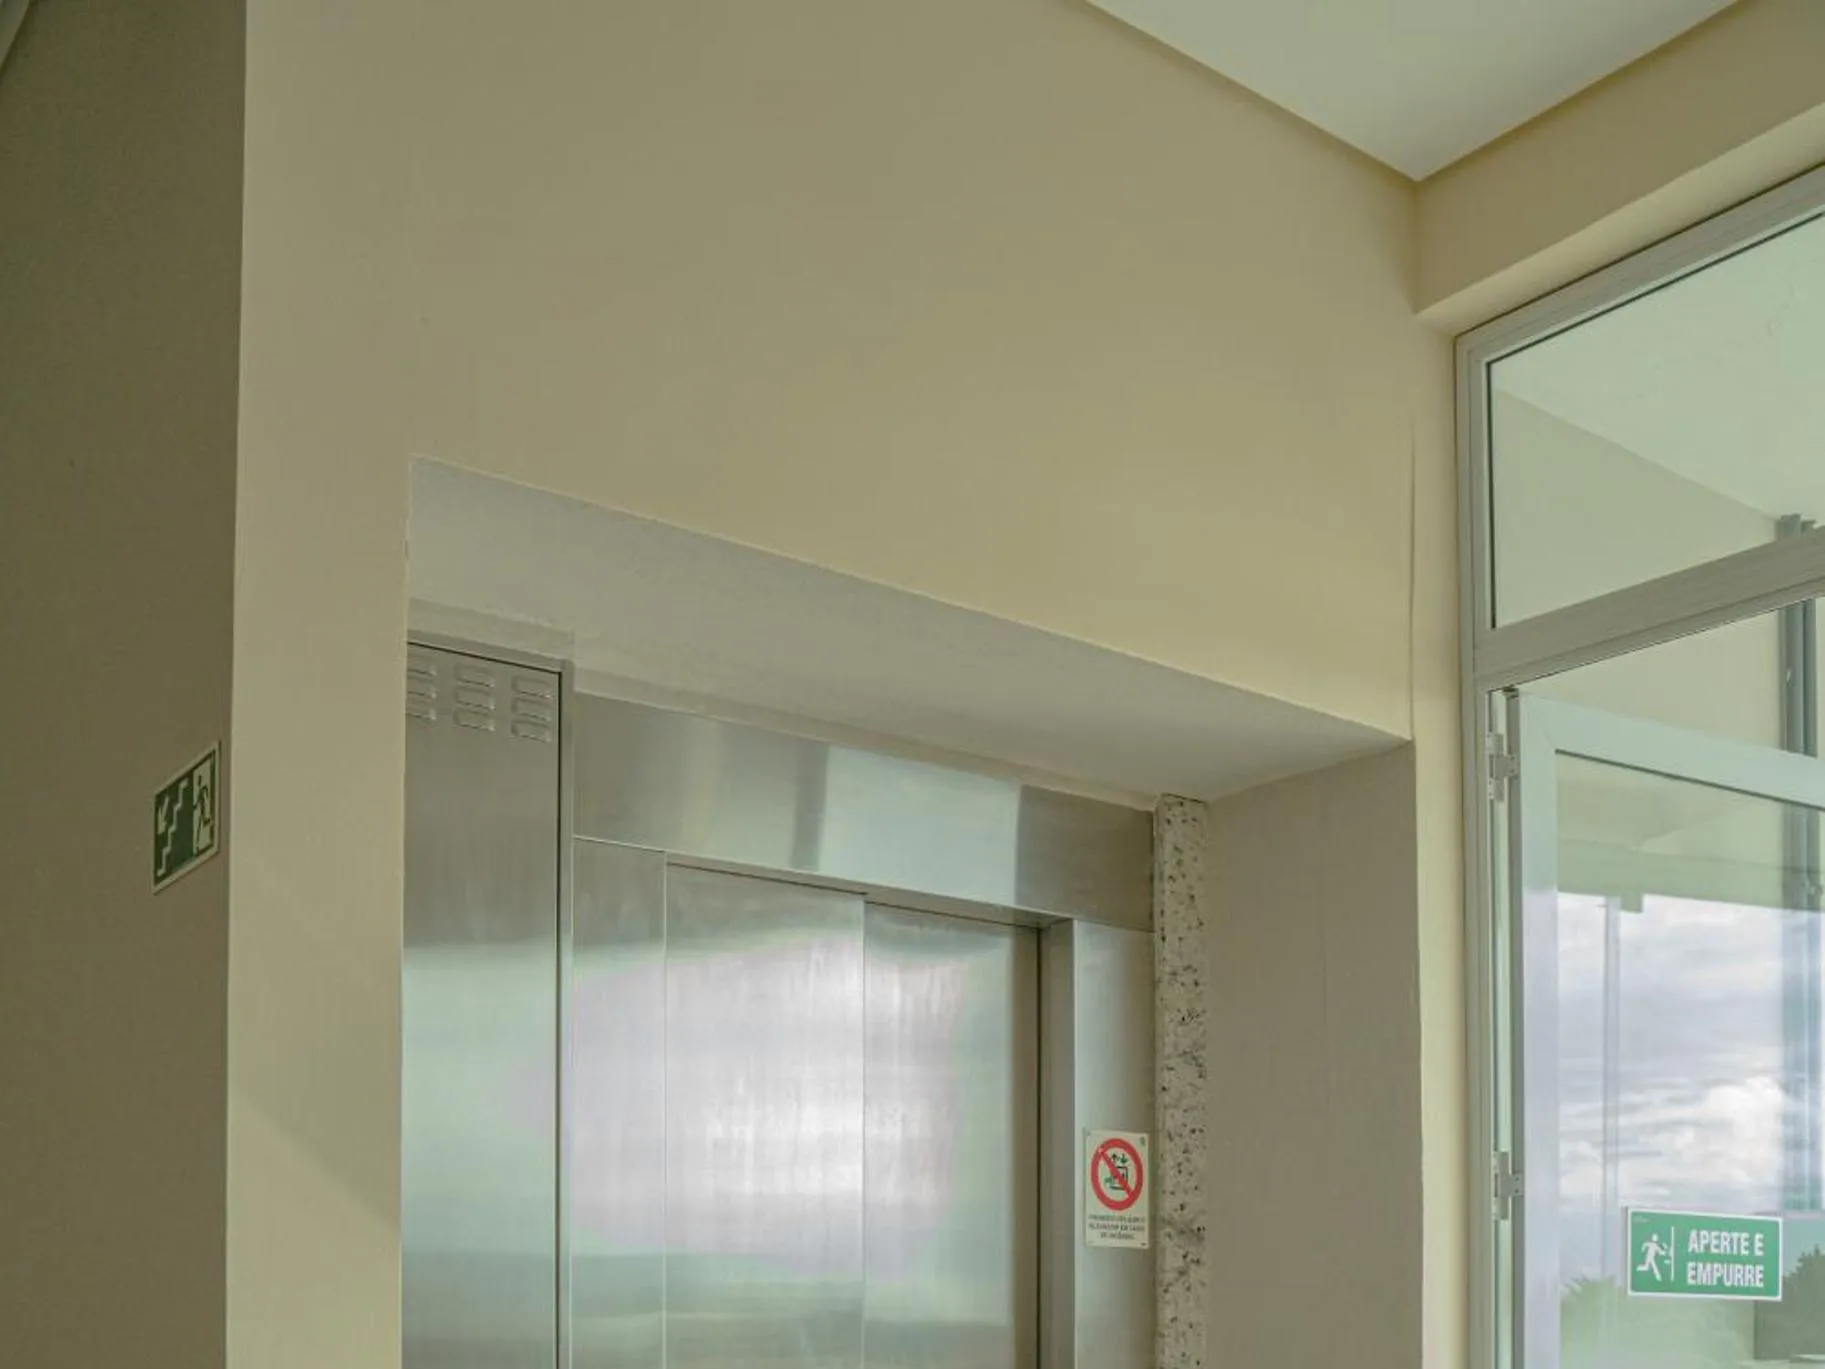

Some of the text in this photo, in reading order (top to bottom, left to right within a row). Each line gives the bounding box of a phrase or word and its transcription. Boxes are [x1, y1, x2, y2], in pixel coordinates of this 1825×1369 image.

[1688, 1229, 1764, 1256] APERTE E
[1687, 1262, 1764, 1288] EMPURRE
